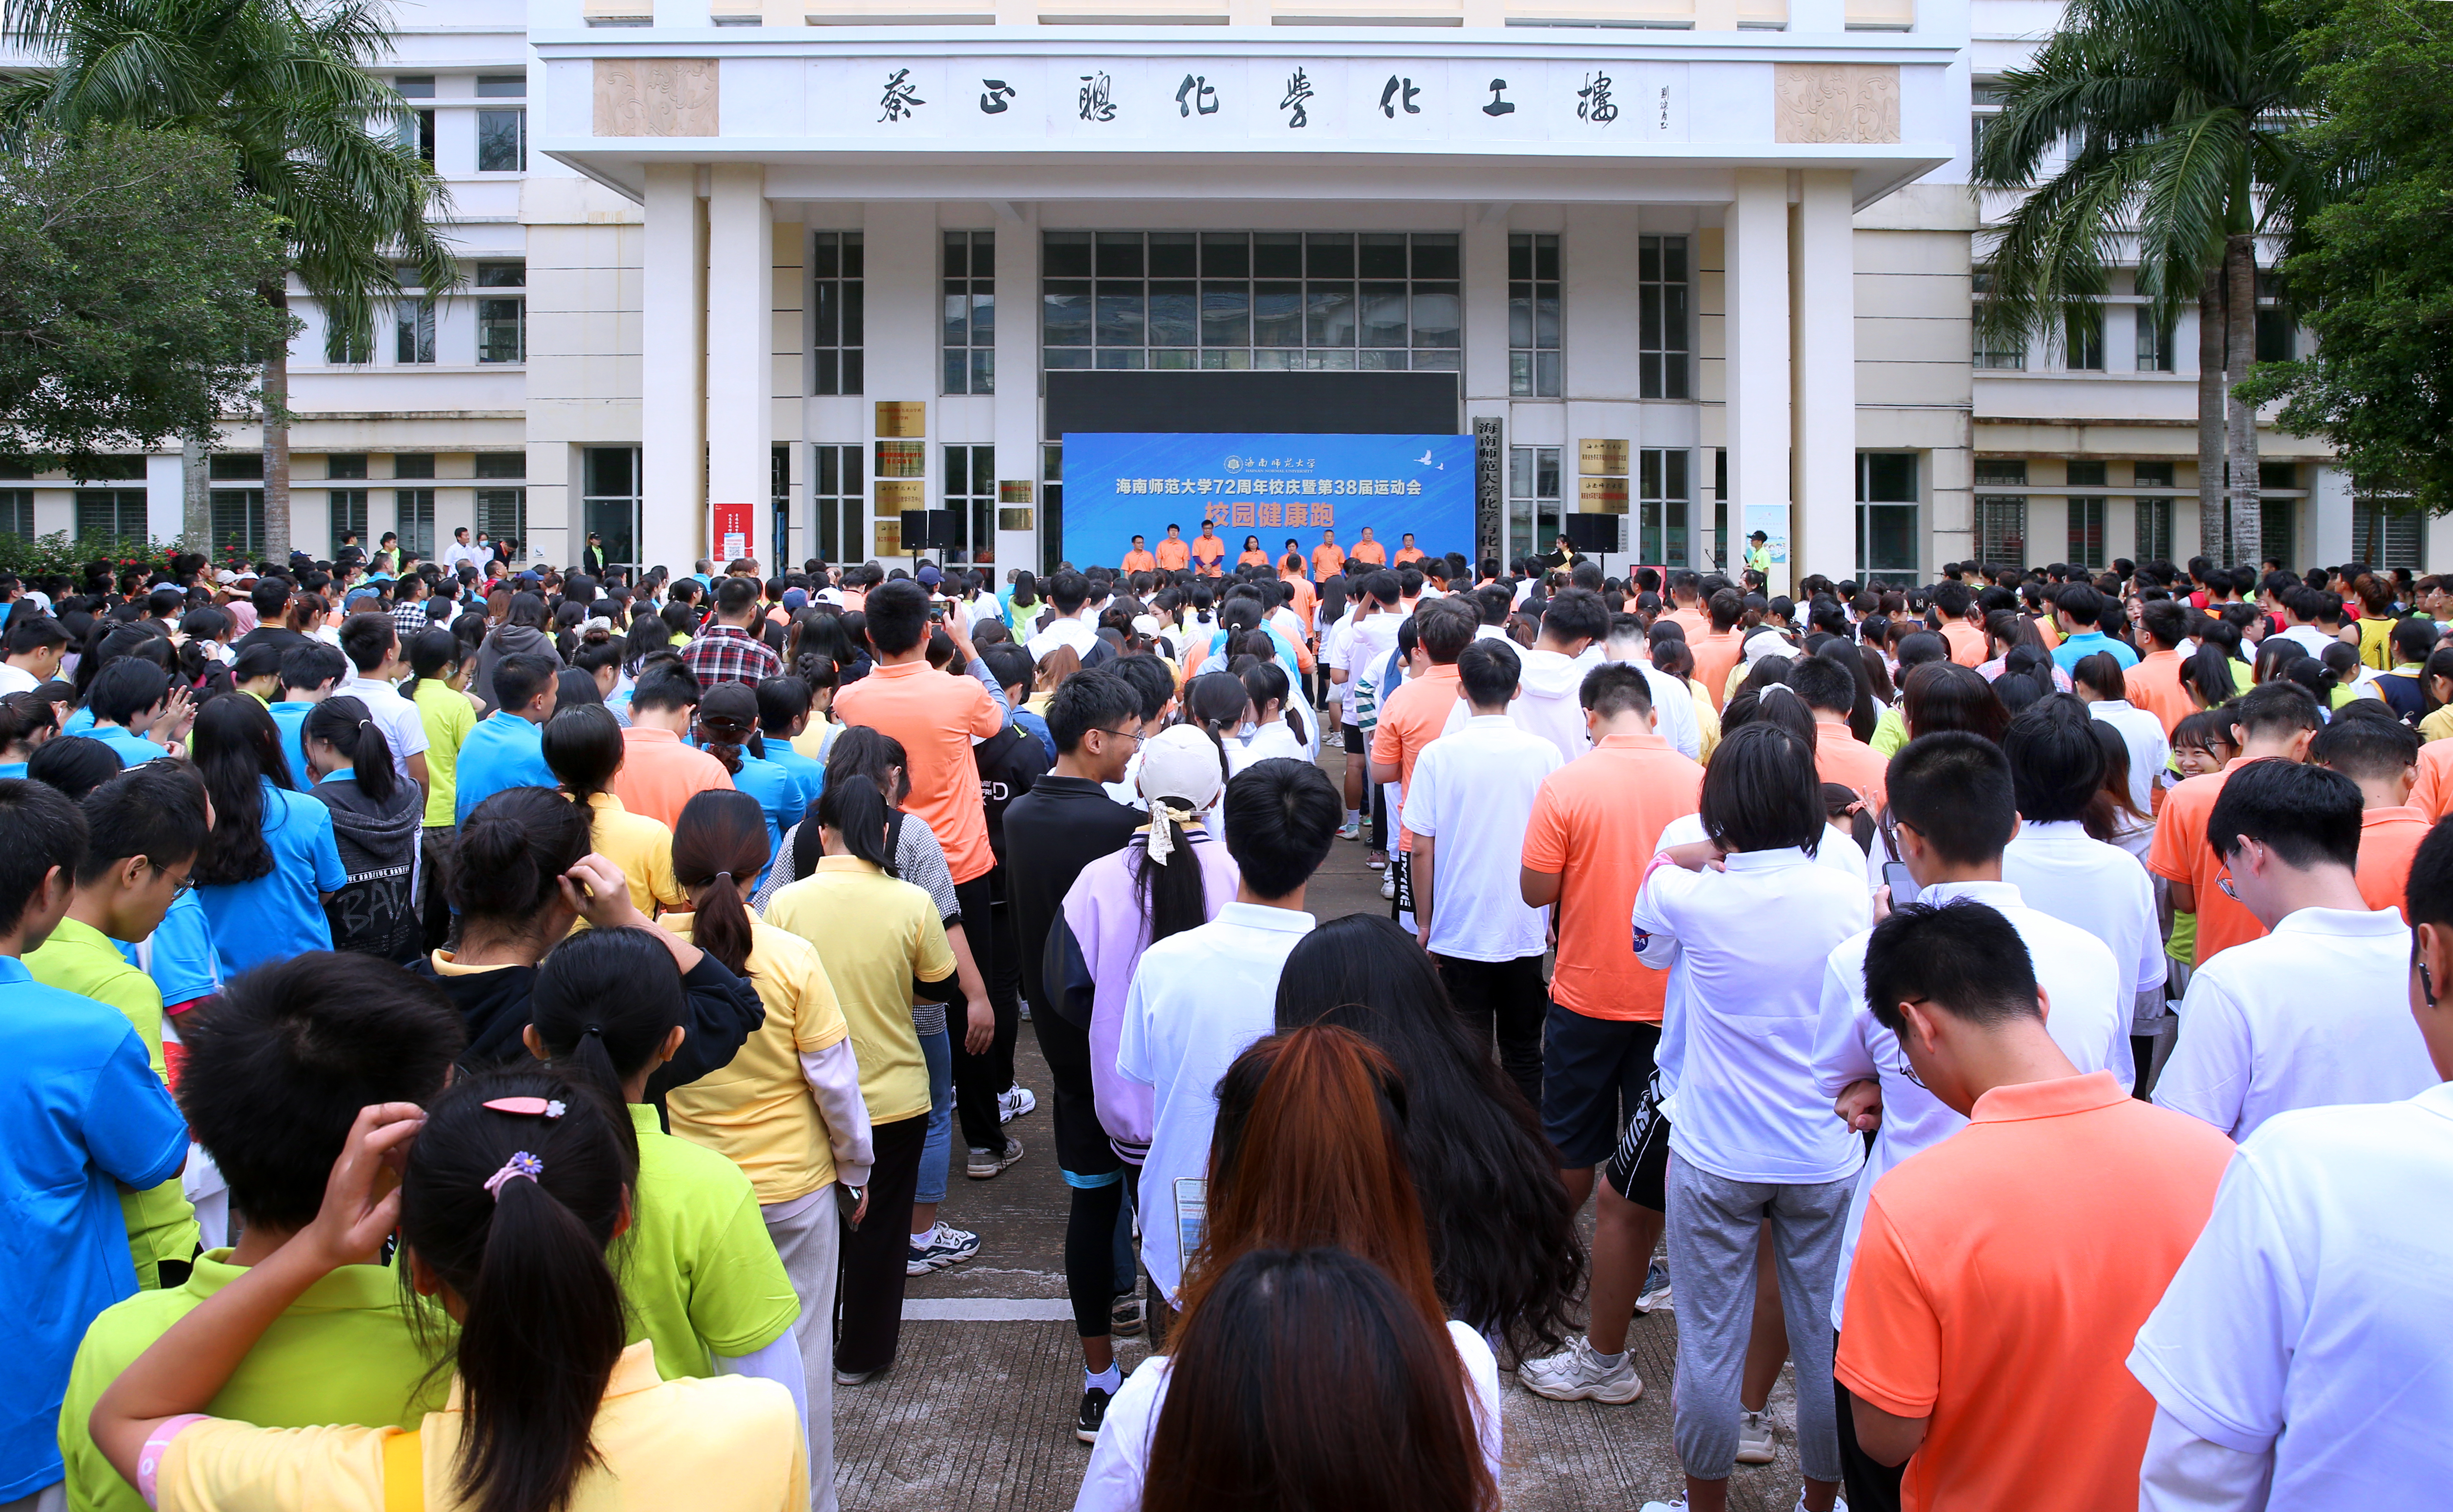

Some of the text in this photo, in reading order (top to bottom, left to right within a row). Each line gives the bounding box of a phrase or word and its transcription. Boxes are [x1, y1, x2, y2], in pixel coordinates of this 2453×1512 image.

[1244, 457, 1315, 469] 海南师范大学
[1116, 478, 1422, 496] 海南师范大学72周年校庆暨第38届运动会
[1478, 423, 1498, 560] 海南师范大学化学与化工
[1205, 502, 1335, 528] 校园健康跑
[993, 782, 1009, 801] D
